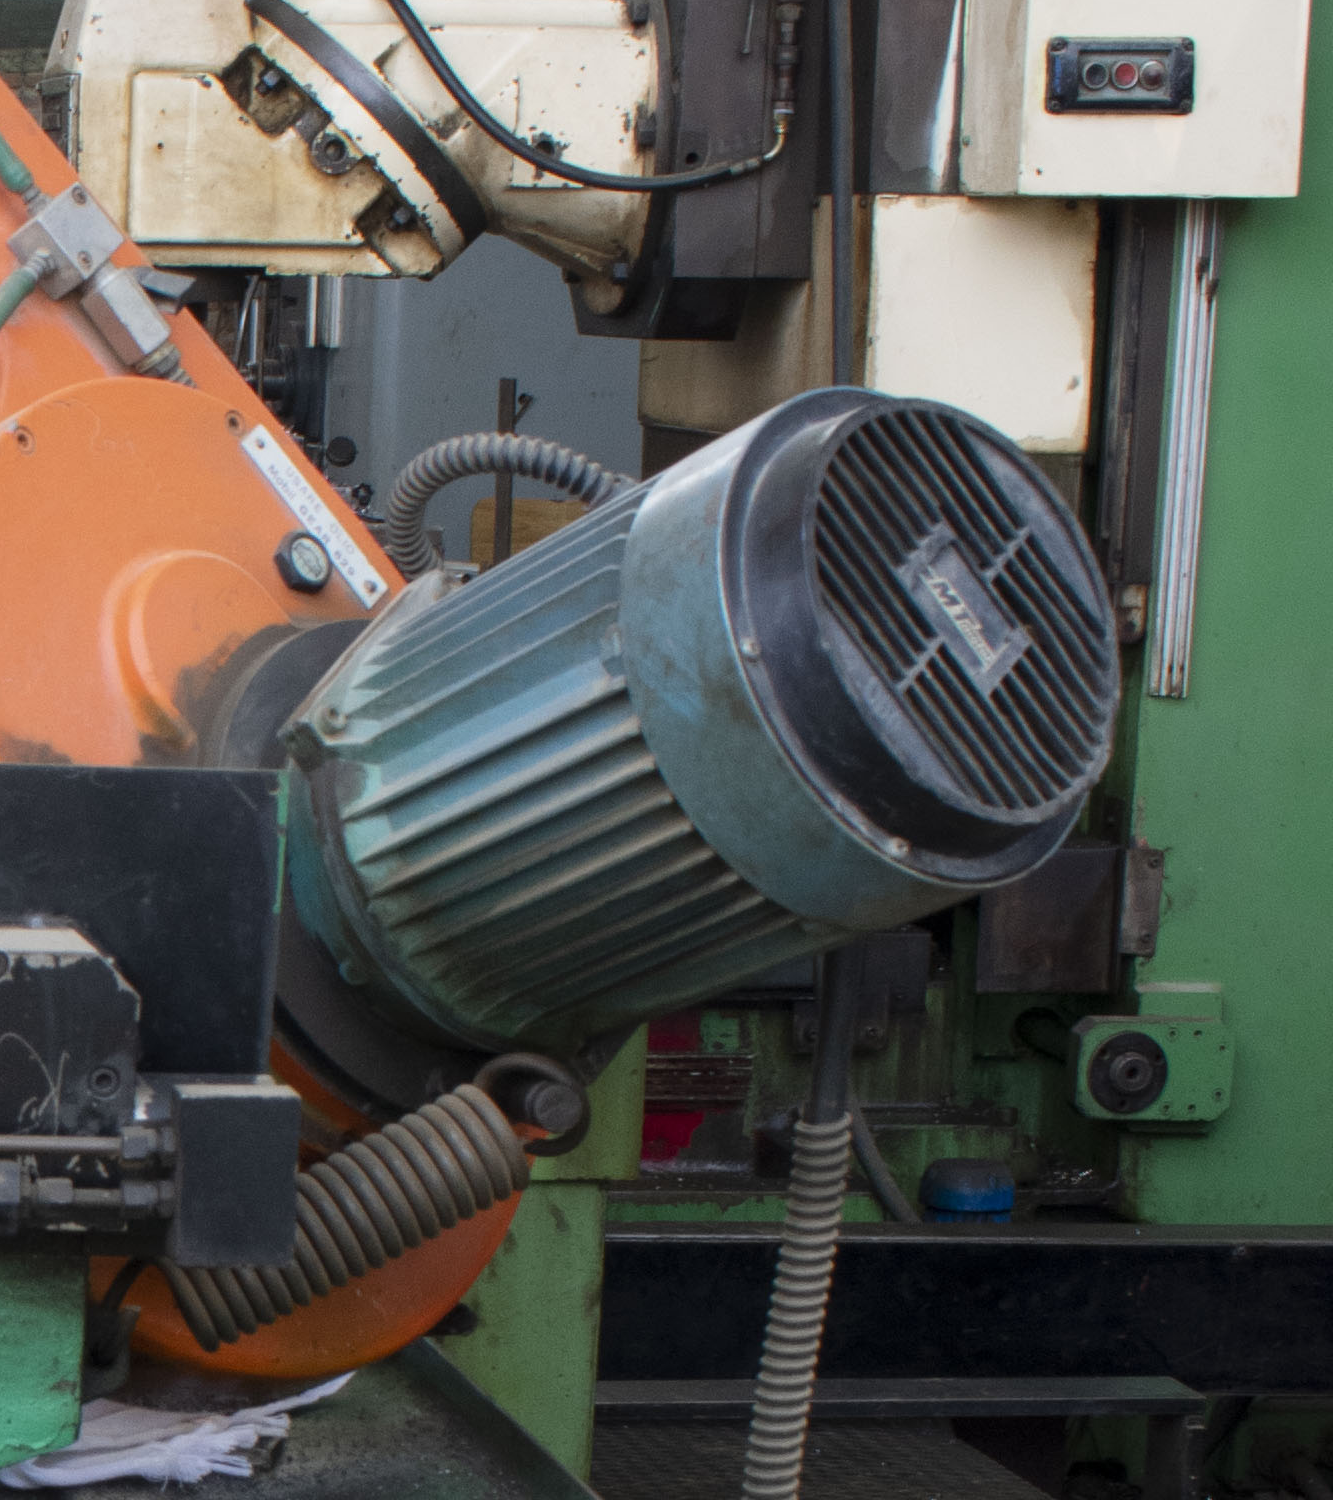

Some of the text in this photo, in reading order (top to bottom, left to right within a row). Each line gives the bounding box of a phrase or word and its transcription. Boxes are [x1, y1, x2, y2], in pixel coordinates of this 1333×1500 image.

[284, 465, 356, 555] USARE OLIO
[299, 504, 332, 544] GEAR
